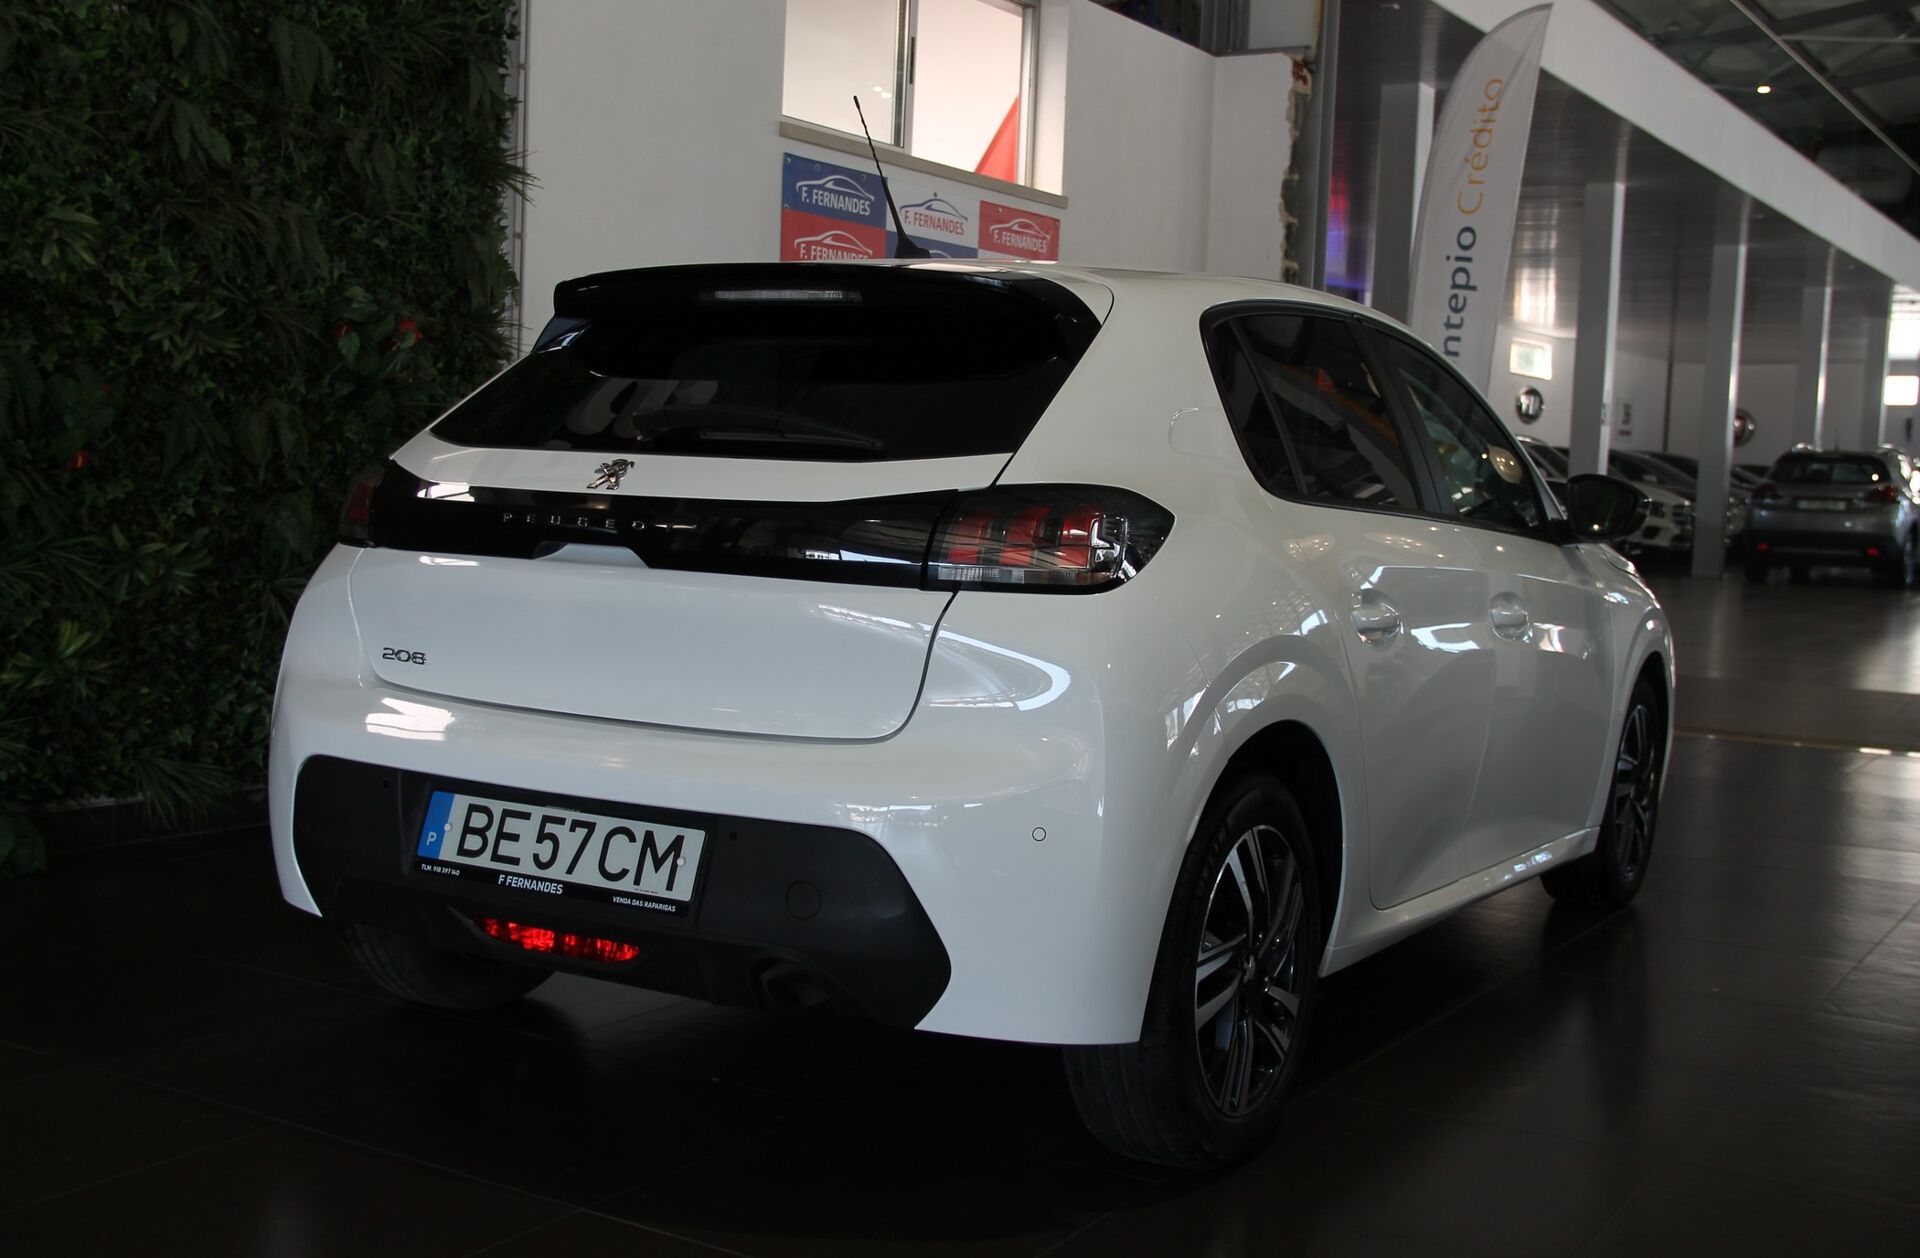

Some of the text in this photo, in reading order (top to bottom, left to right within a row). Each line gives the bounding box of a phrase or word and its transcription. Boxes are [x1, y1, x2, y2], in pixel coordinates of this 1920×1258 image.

[1456, 77, 1504, 215] Crédito
[801, 187, 871, 216] F. FERNANDES
[904, 210, 965, 236] F. FERNANDES
[799, 244, 869, 260] F. FERNAN
[993, 230, 1047, 254] F. FERNANDES
[382, 647, 427, 665] 208
[426, 831, 437, 846] P
[498, 874, 564, 895] F FERNANDES
[612, 896, 676, 912] VENDA DAS RAPARIGAS
